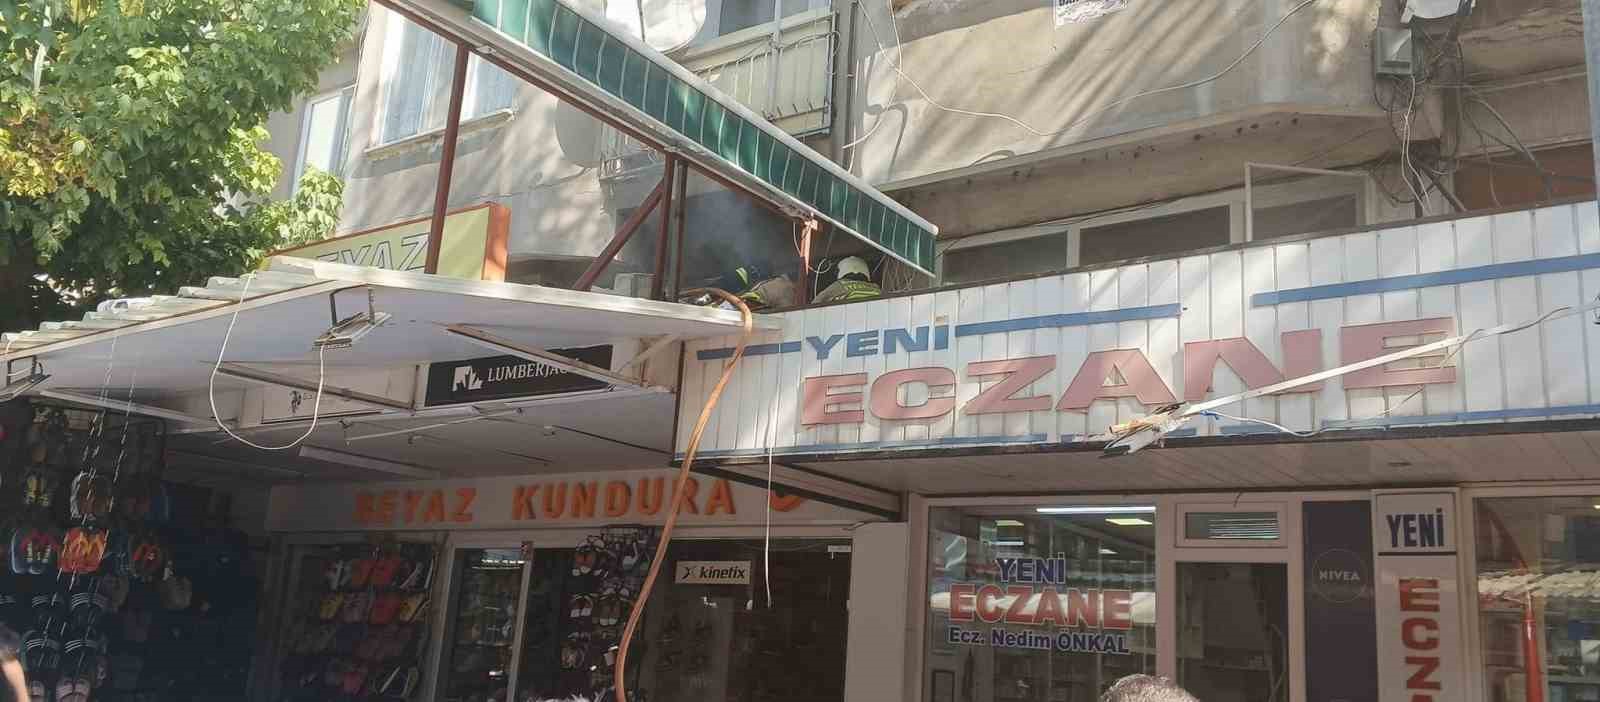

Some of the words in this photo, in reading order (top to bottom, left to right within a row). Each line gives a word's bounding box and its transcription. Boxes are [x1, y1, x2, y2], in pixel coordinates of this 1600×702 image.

[801, 317, 1457, 425] ECZANE
[354, 487, 477, 525] BEYAZ
[512, 475, 737, 521] KUNDURA
[1386, 508, 1445, 548] YENİ
[700, 556, 745, 579] kinetix
[995, 552, 1066, 583] YENİ
[1319, 571, 1360, 581] NIVEA
[949, 584, 1133, 630] ECZANE
[949, 626, 985, 645] Ecz.
[992, 628, 1050, 649] Nedim
[1057, 630, 1130, 654] ÖNKAL
[1399, 578, 1442, 702] ECZ
